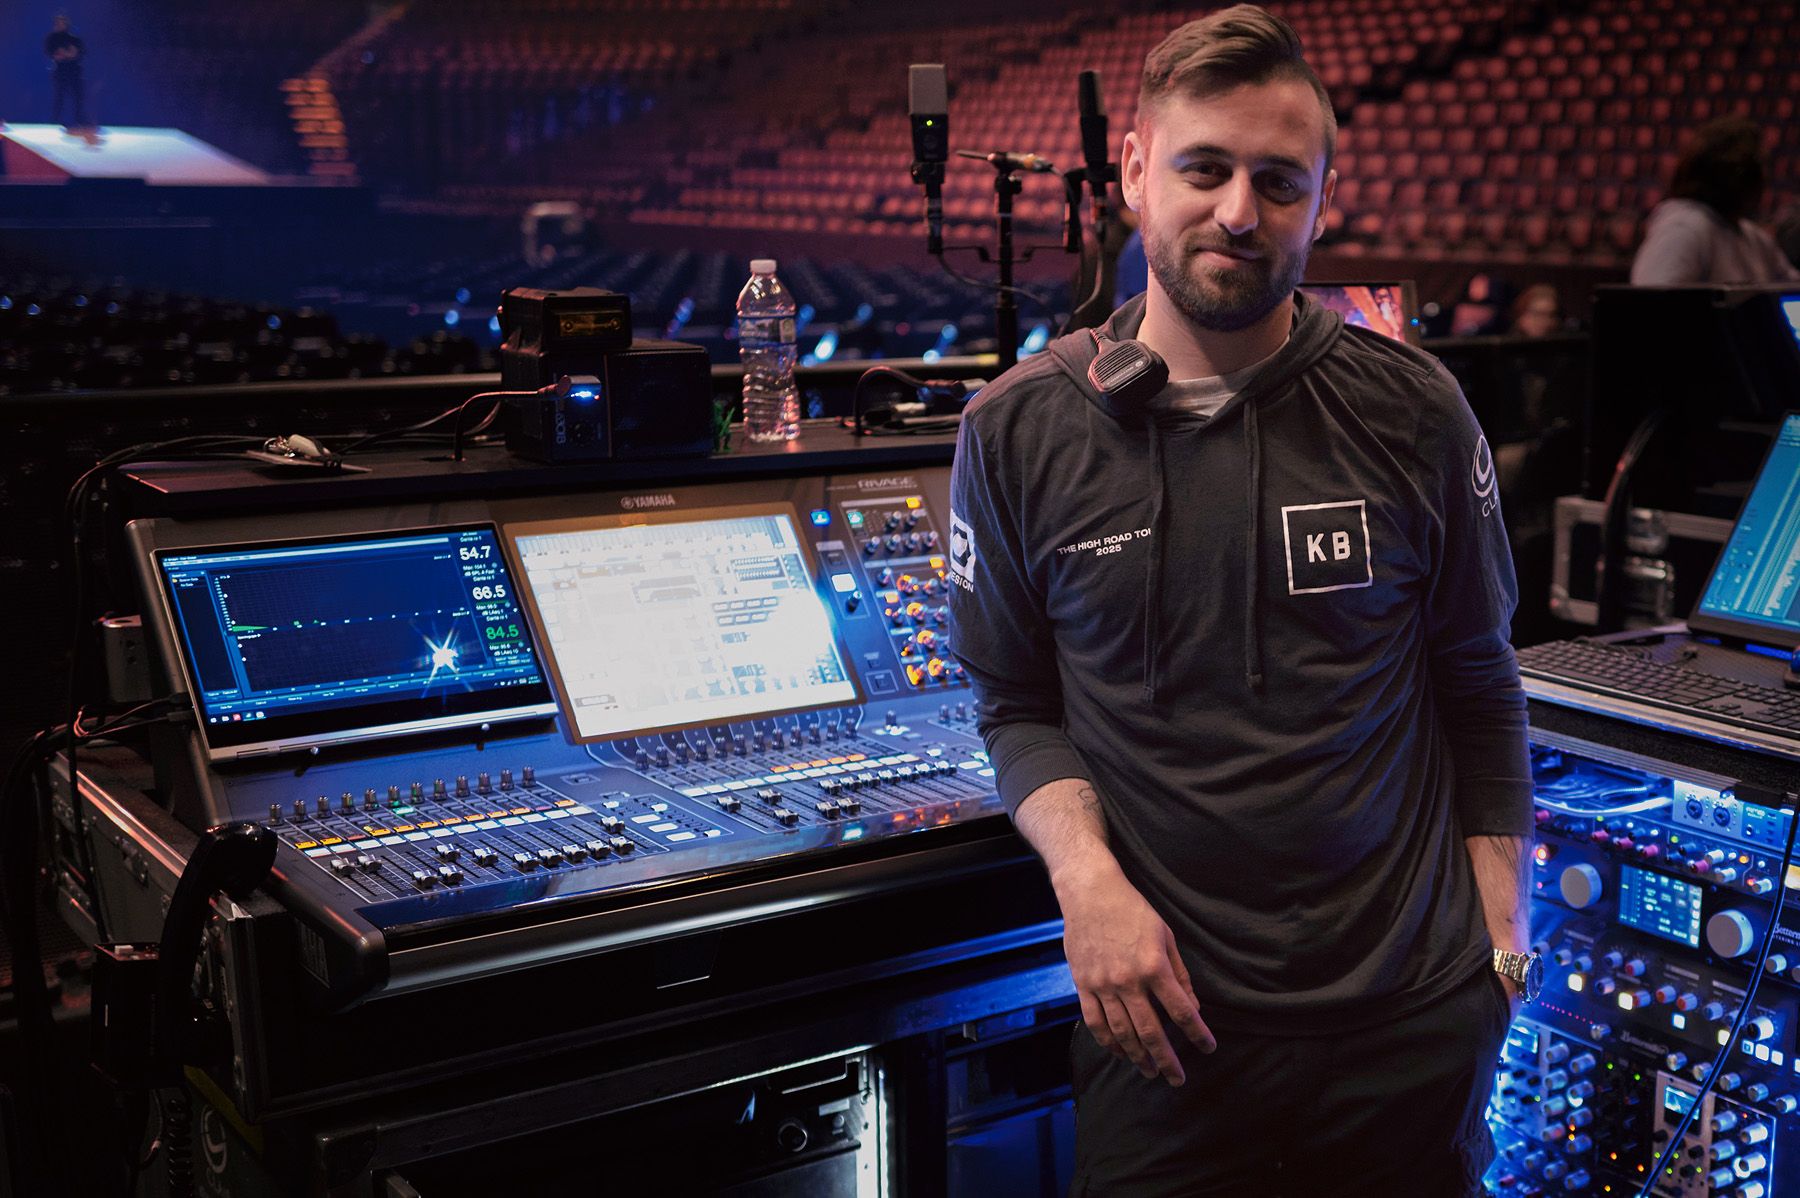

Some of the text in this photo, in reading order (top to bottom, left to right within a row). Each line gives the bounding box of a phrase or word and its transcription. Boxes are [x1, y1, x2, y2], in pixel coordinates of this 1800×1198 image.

[633, 494, 676, 508] YAMAHA
[1057, 544, 1077, 555] THE
[1077, 539, 1102, 551] HIGH
[1103, 532, 1133, 545] ROAD
[1096, 544, 1122, 556] 2025
[459, 545, 491, 560] 54.7
[472, 584, 506, 600] 66.5
[485, 624, 519, 640] 84.5
